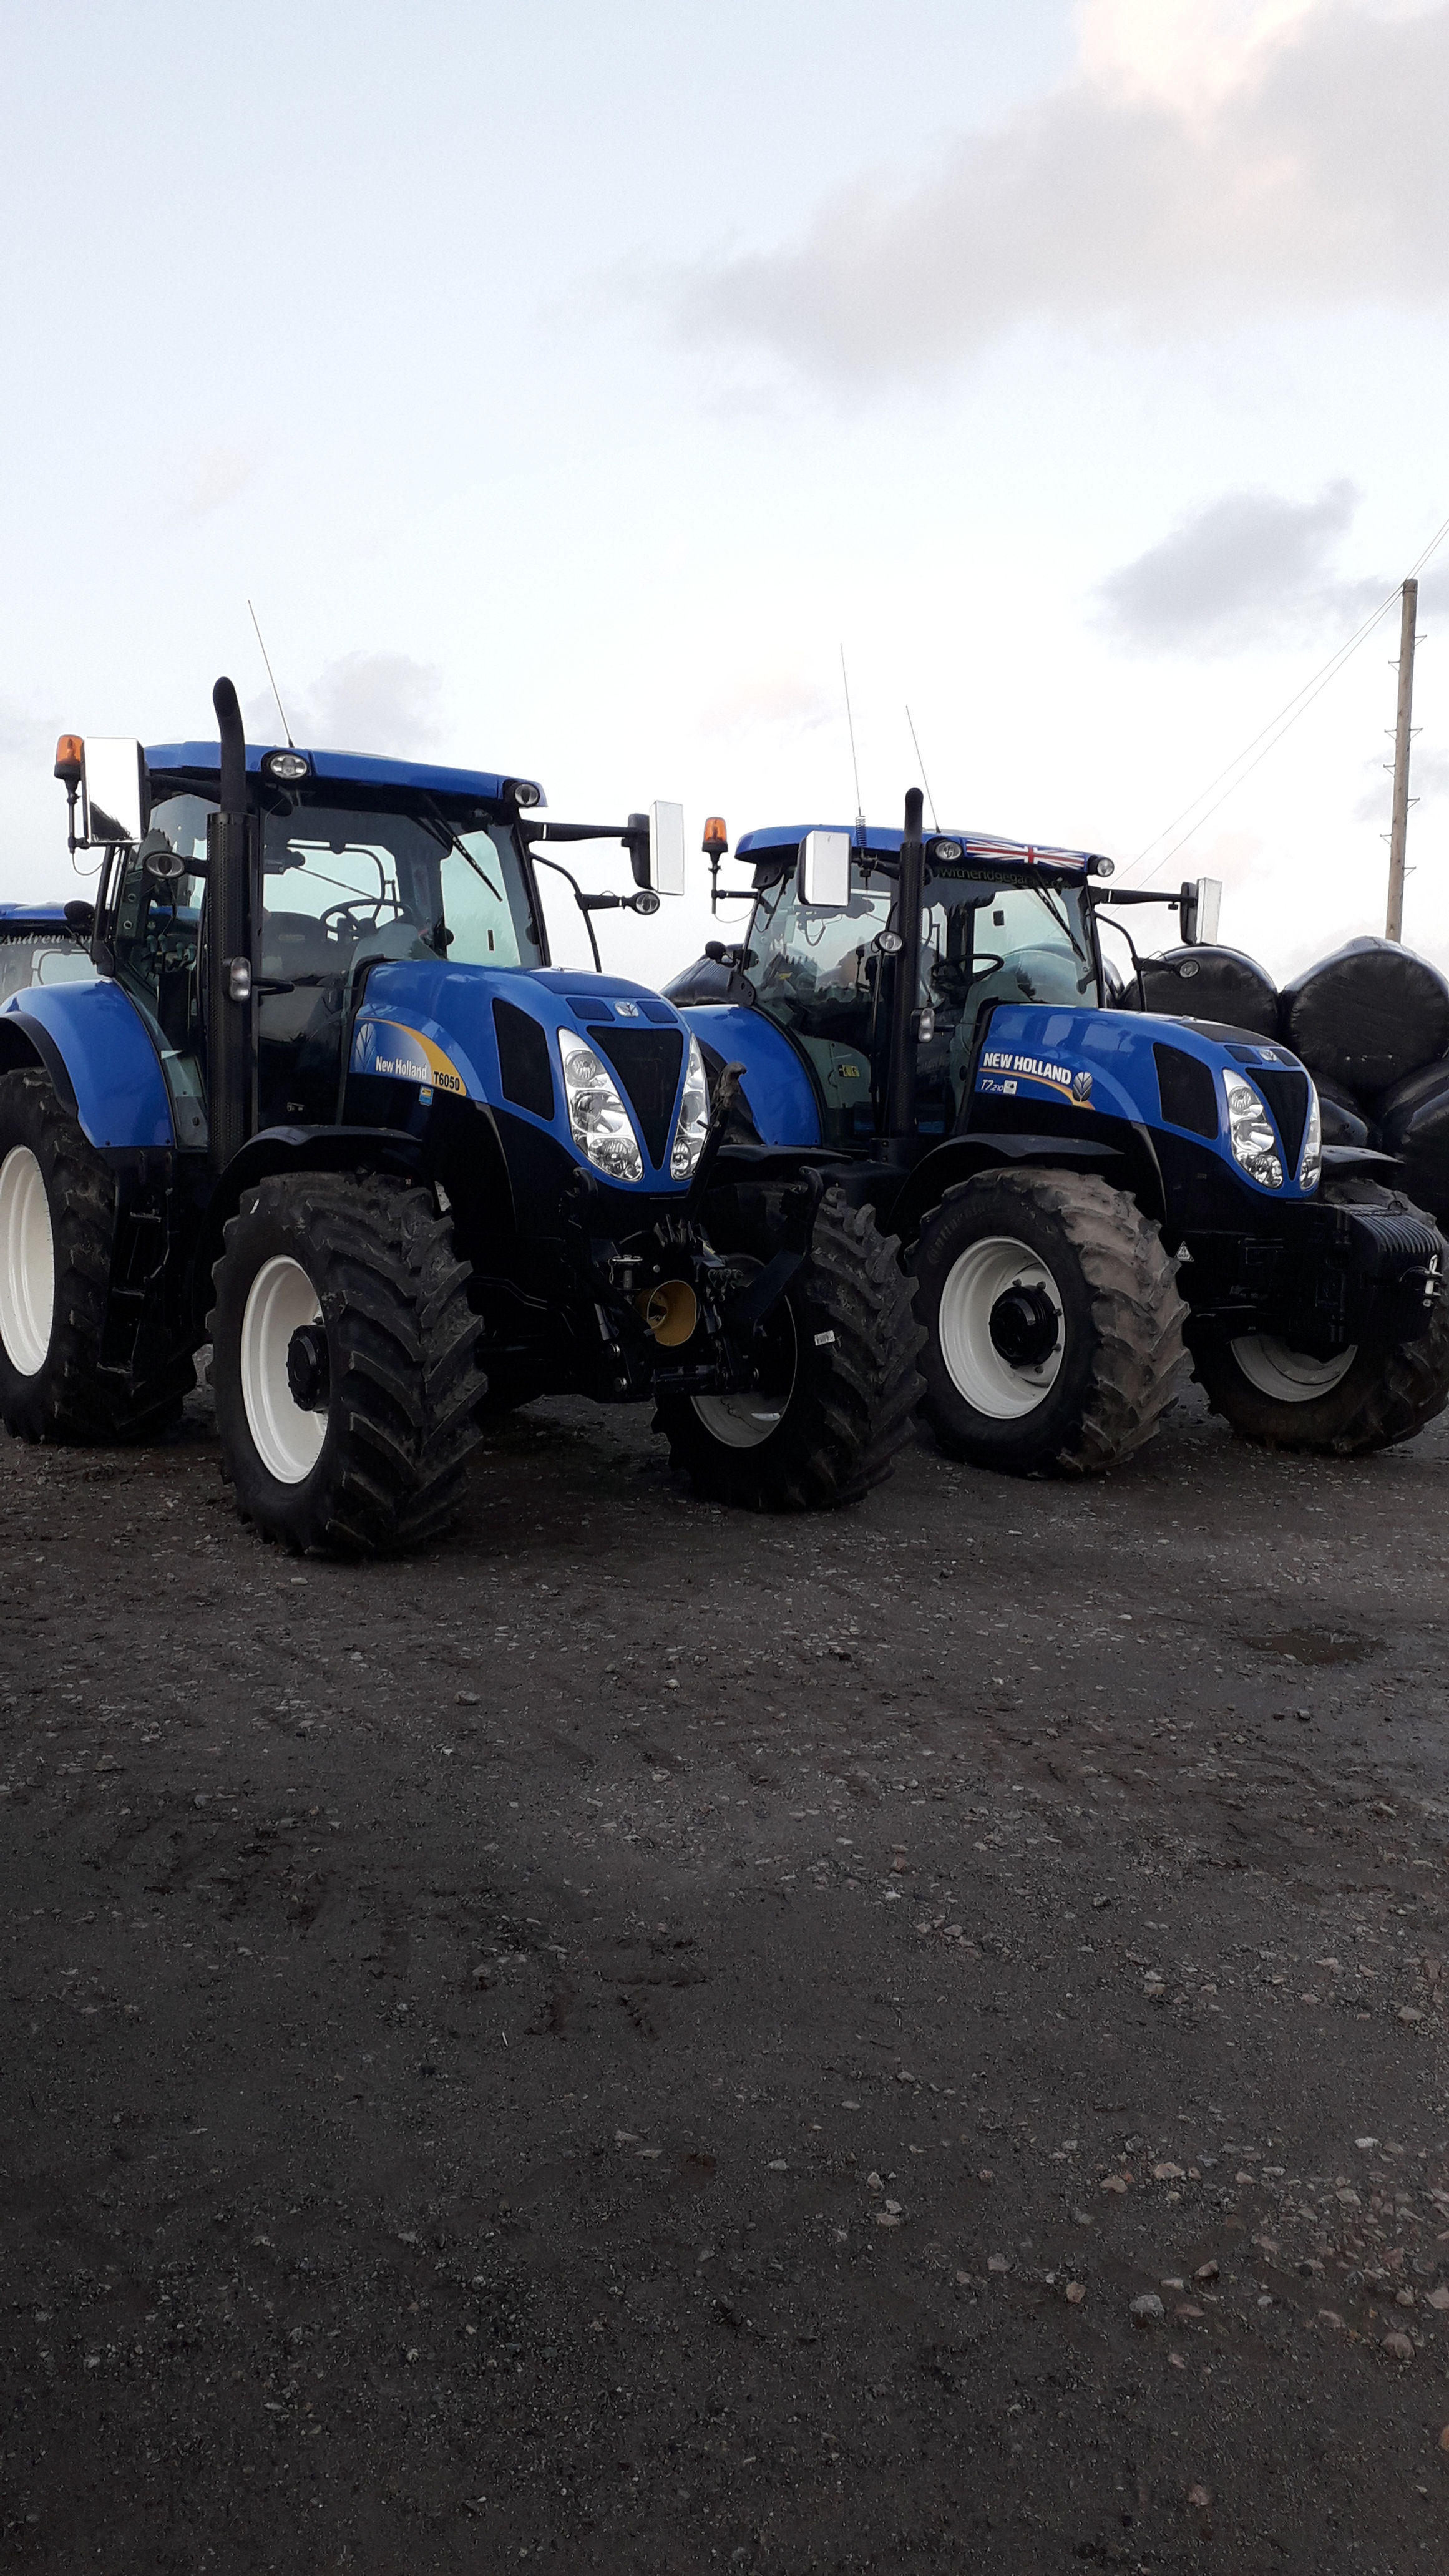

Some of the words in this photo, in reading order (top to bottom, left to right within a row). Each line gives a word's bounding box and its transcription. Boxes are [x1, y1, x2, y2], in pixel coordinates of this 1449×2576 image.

[1, 932, 65, 946] Andrew
[376, 1056, 394, 1073] New
[394, 1058, 427, 1080] Holland
[983, 1052, 1013, 1069] NEW
[1013, 1056, 1072, 1085] HOLLAND
[434, 1071, 460, 1091] T6050
